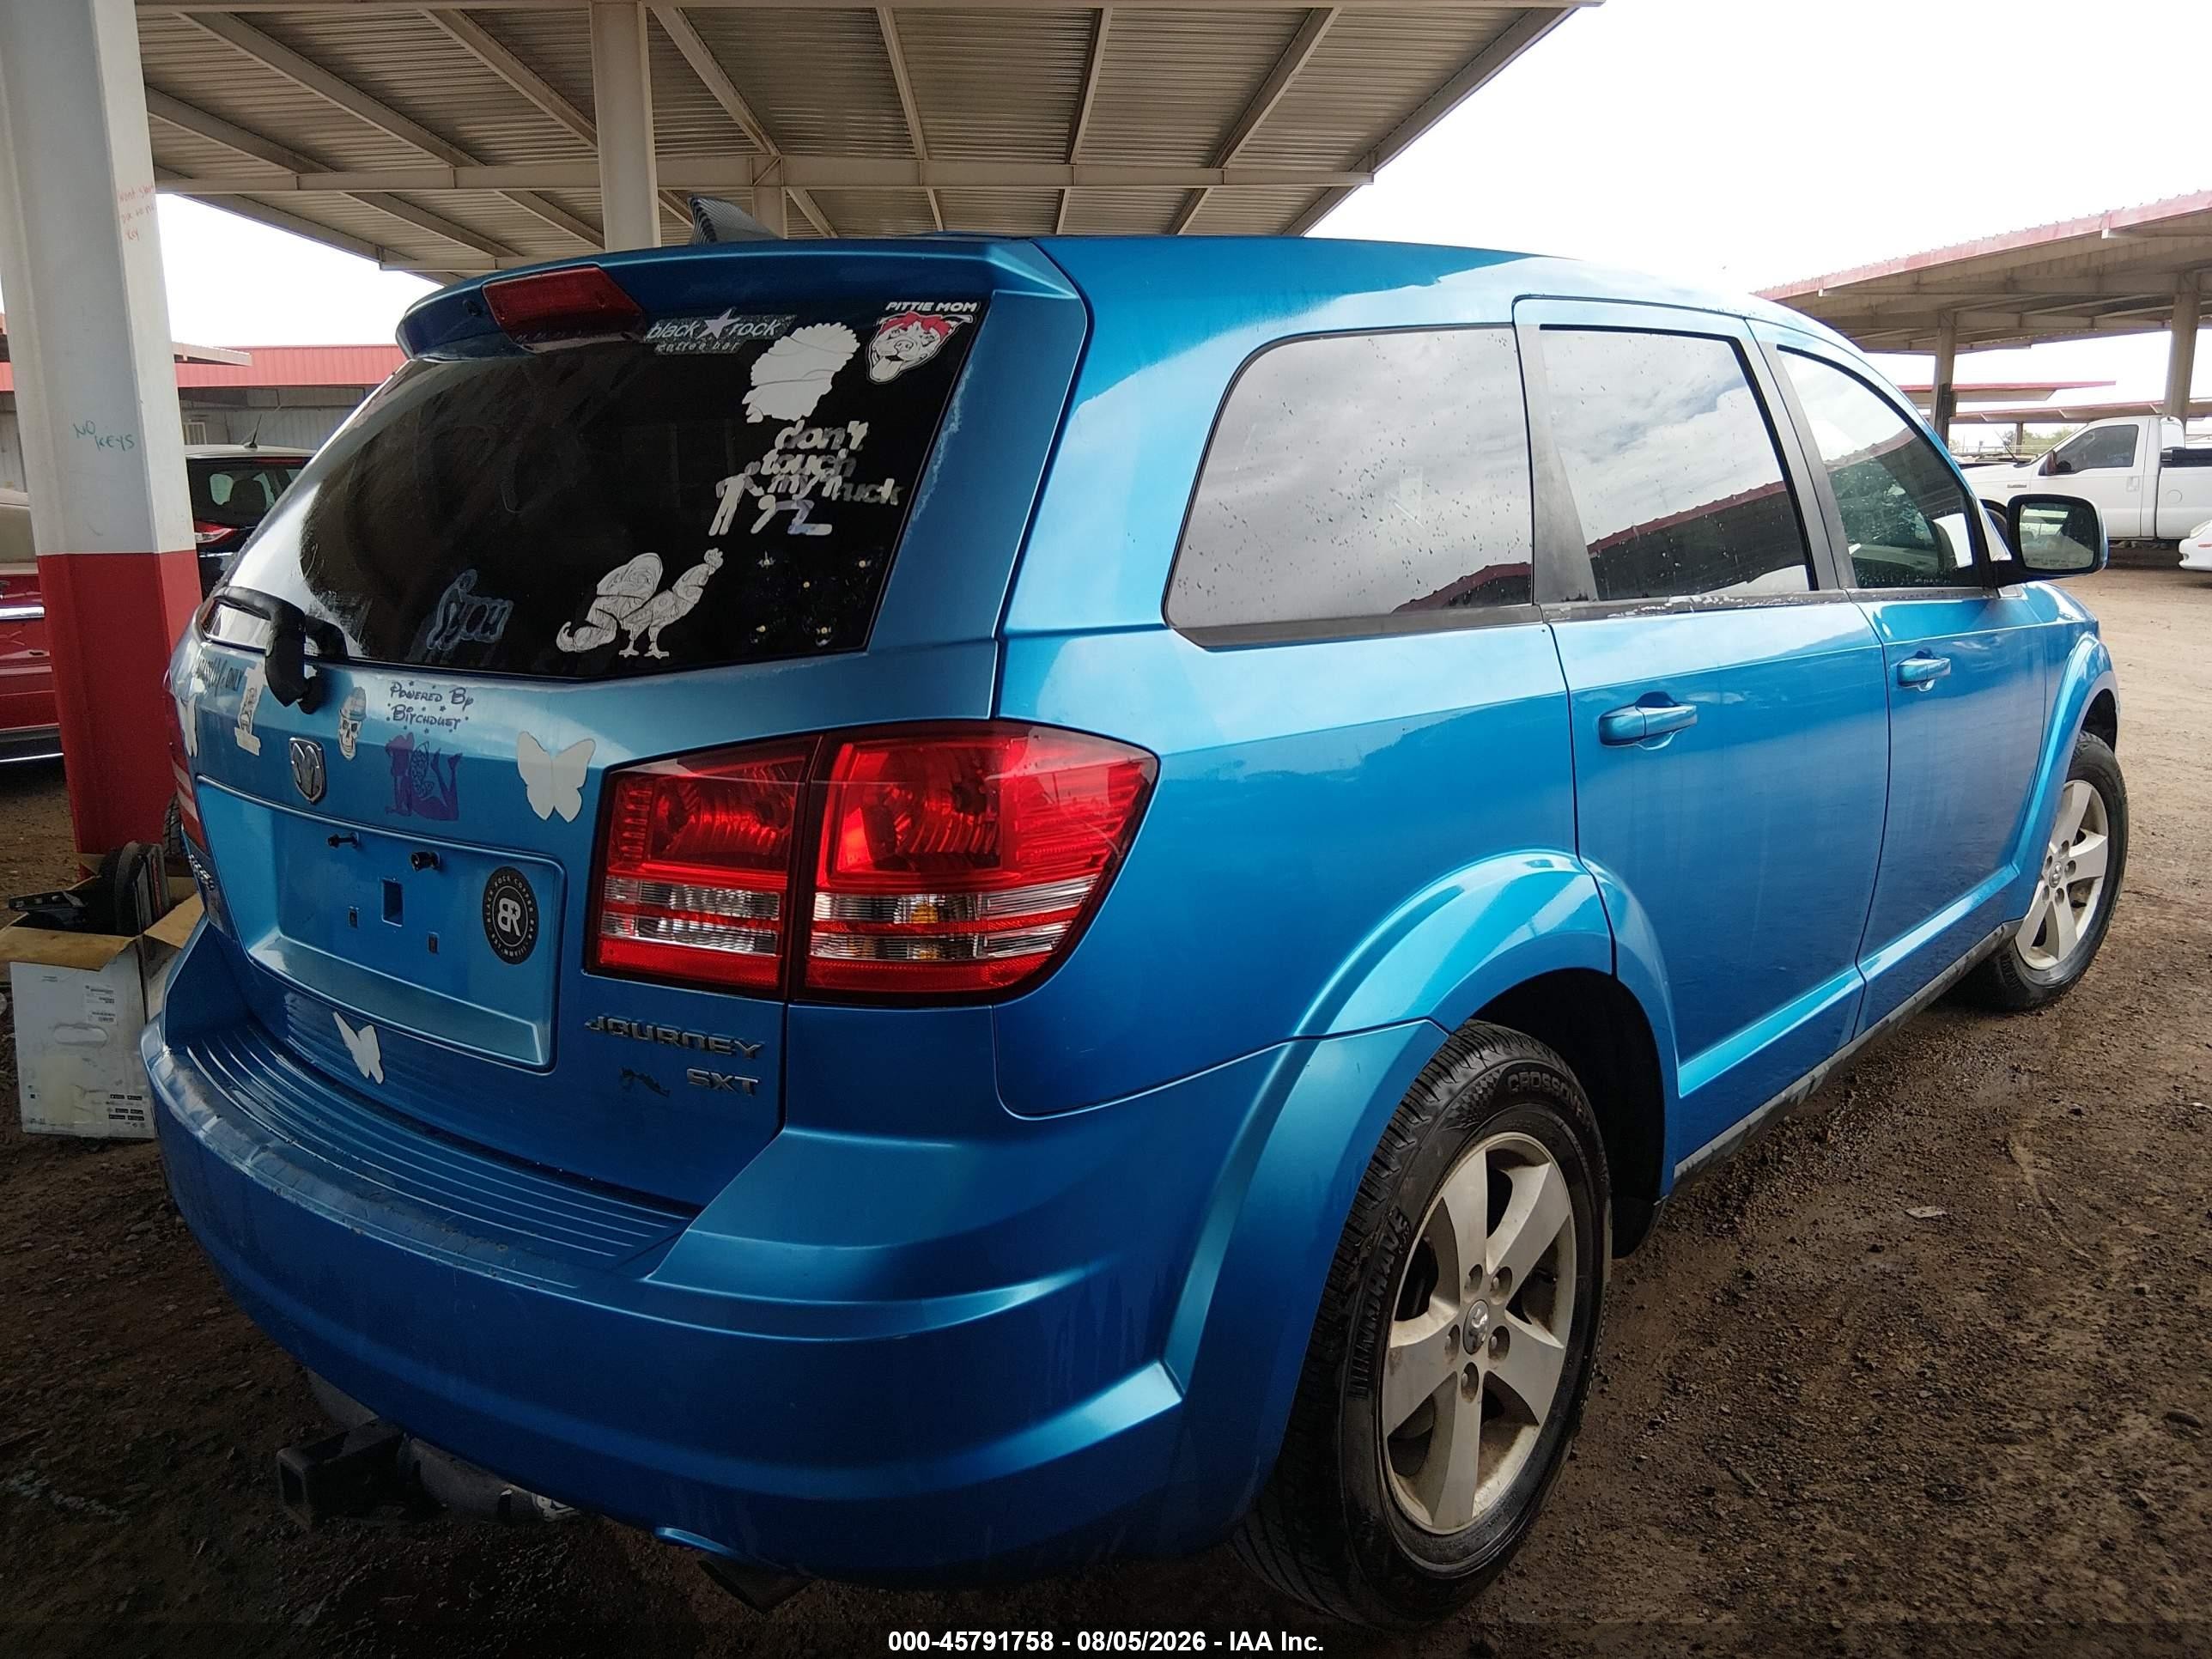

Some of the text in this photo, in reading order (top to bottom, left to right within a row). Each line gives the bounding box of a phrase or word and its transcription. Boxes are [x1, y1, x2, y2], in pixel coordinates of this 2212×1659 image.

[885, 301, 977, 313] PITTIE MOM
[646, 318, 782, 339] black rock
[72, 420, 95, 439] NO
[94, 434, 135, 452] KEYS
[768, 473, 821, 501] my
[583, 1014, 764, 1060] JOURNEY
[687, 1067, 760, 1096] SXT
